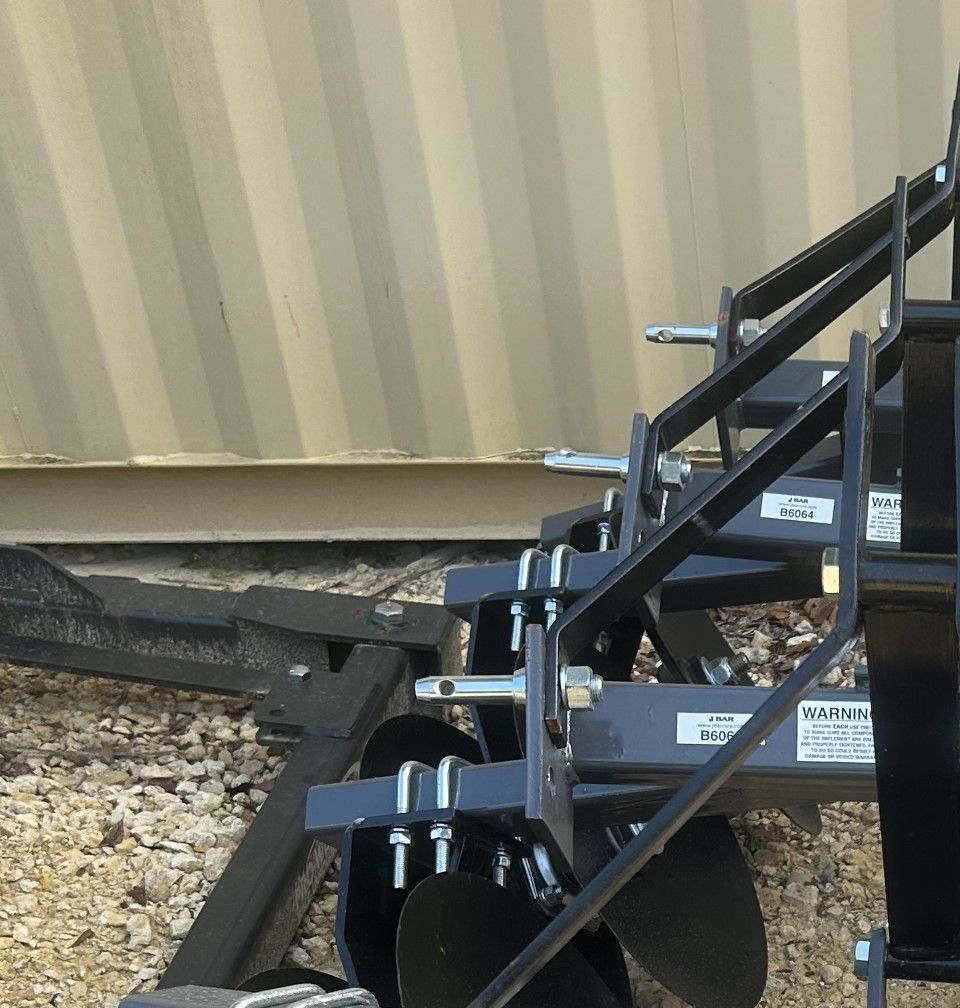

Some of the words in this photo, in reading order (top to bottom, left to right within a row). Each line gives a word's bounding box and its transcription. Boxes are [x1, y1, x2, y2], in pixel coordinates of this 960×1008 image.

[780, 508, 814, 519] B6064
[802, 706, 873, 720] WARNIN
[700, 730, 735, 742] B606
